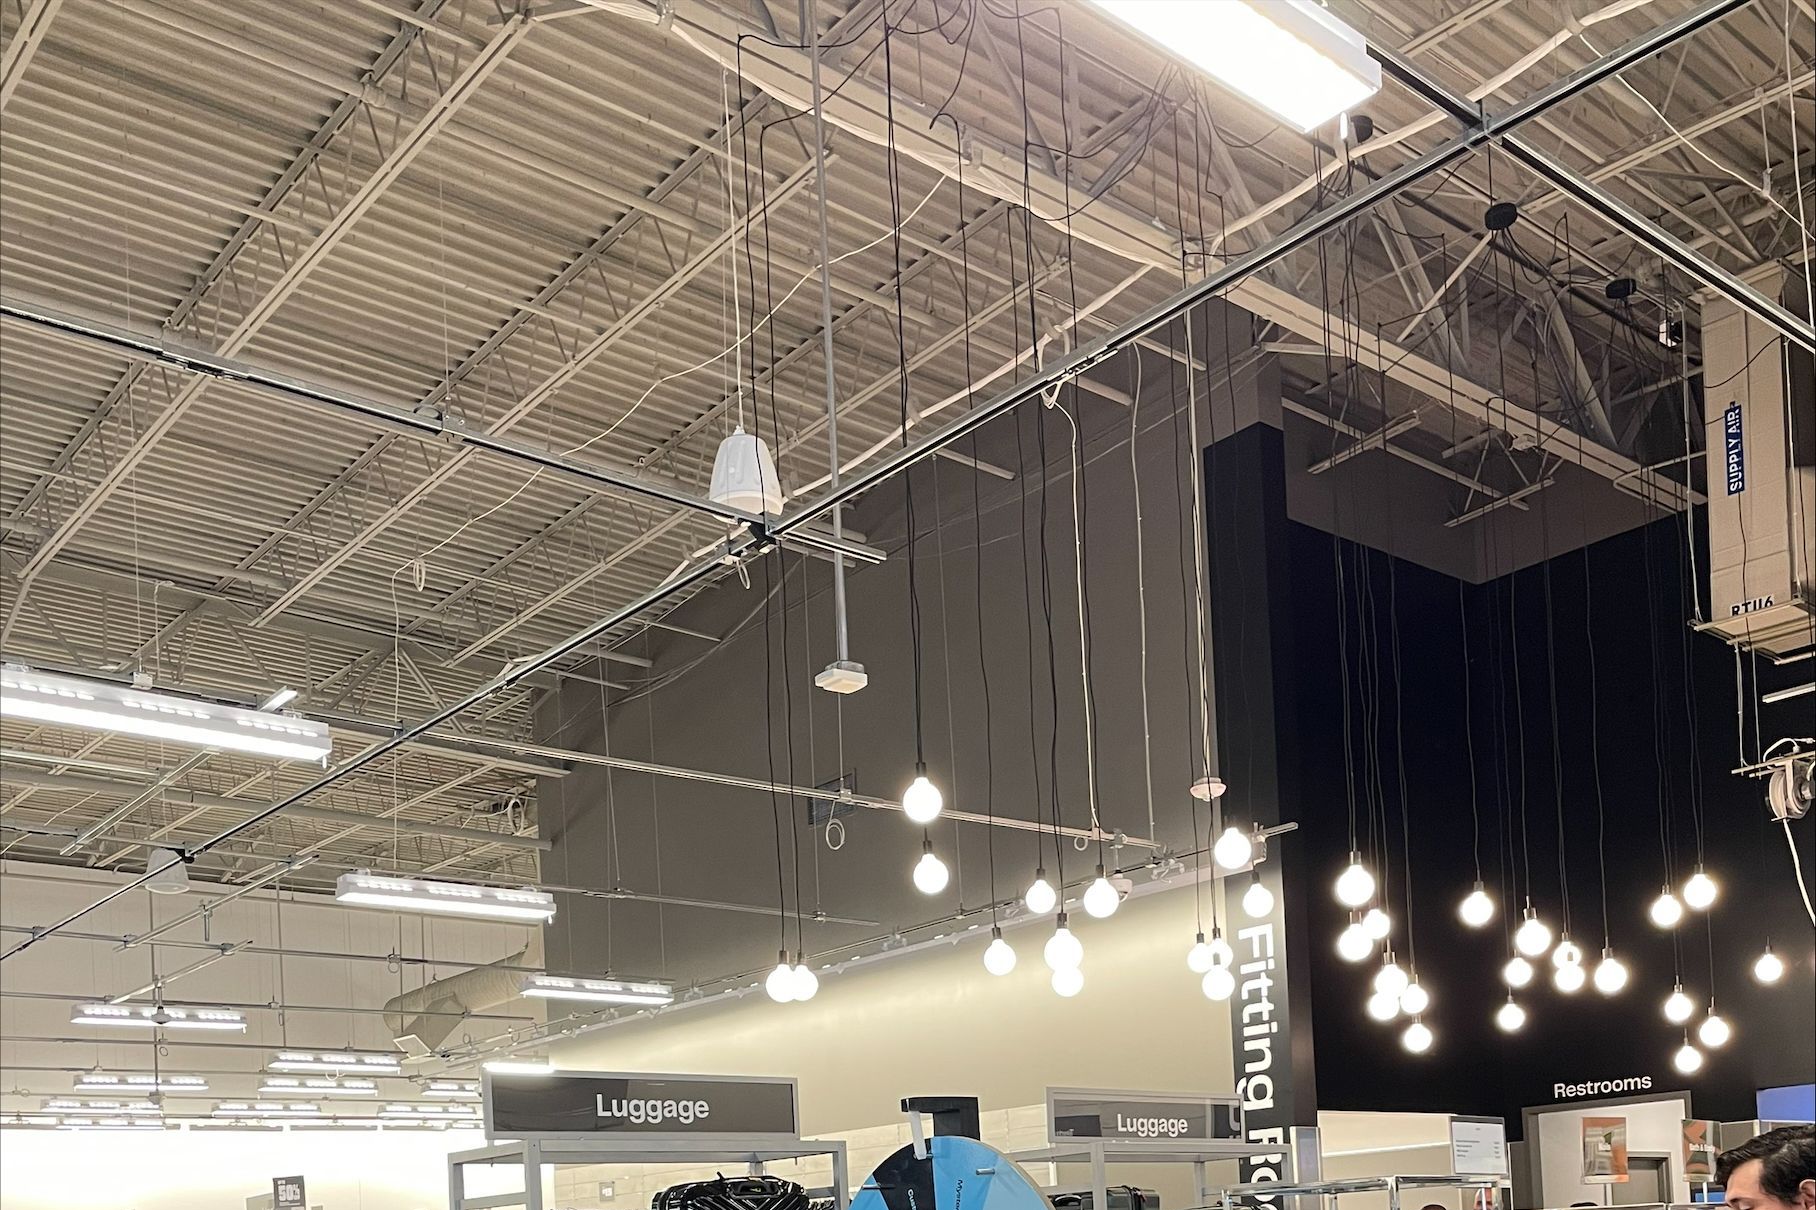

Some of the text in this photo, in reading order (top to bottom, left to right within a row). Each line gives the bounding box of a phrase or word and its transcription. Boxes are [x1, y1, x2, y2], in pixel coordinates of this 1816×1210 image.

[1727, 405, 1743, 492] SUPPLY AIR
[1237, 923, 1278, 1111] Fitting
[1554, 1075, 1652, 1099] Restrooms
[596, 1093, 710, 1125] Luggage
[1117, 1113, 1188, 1138] Luggage
